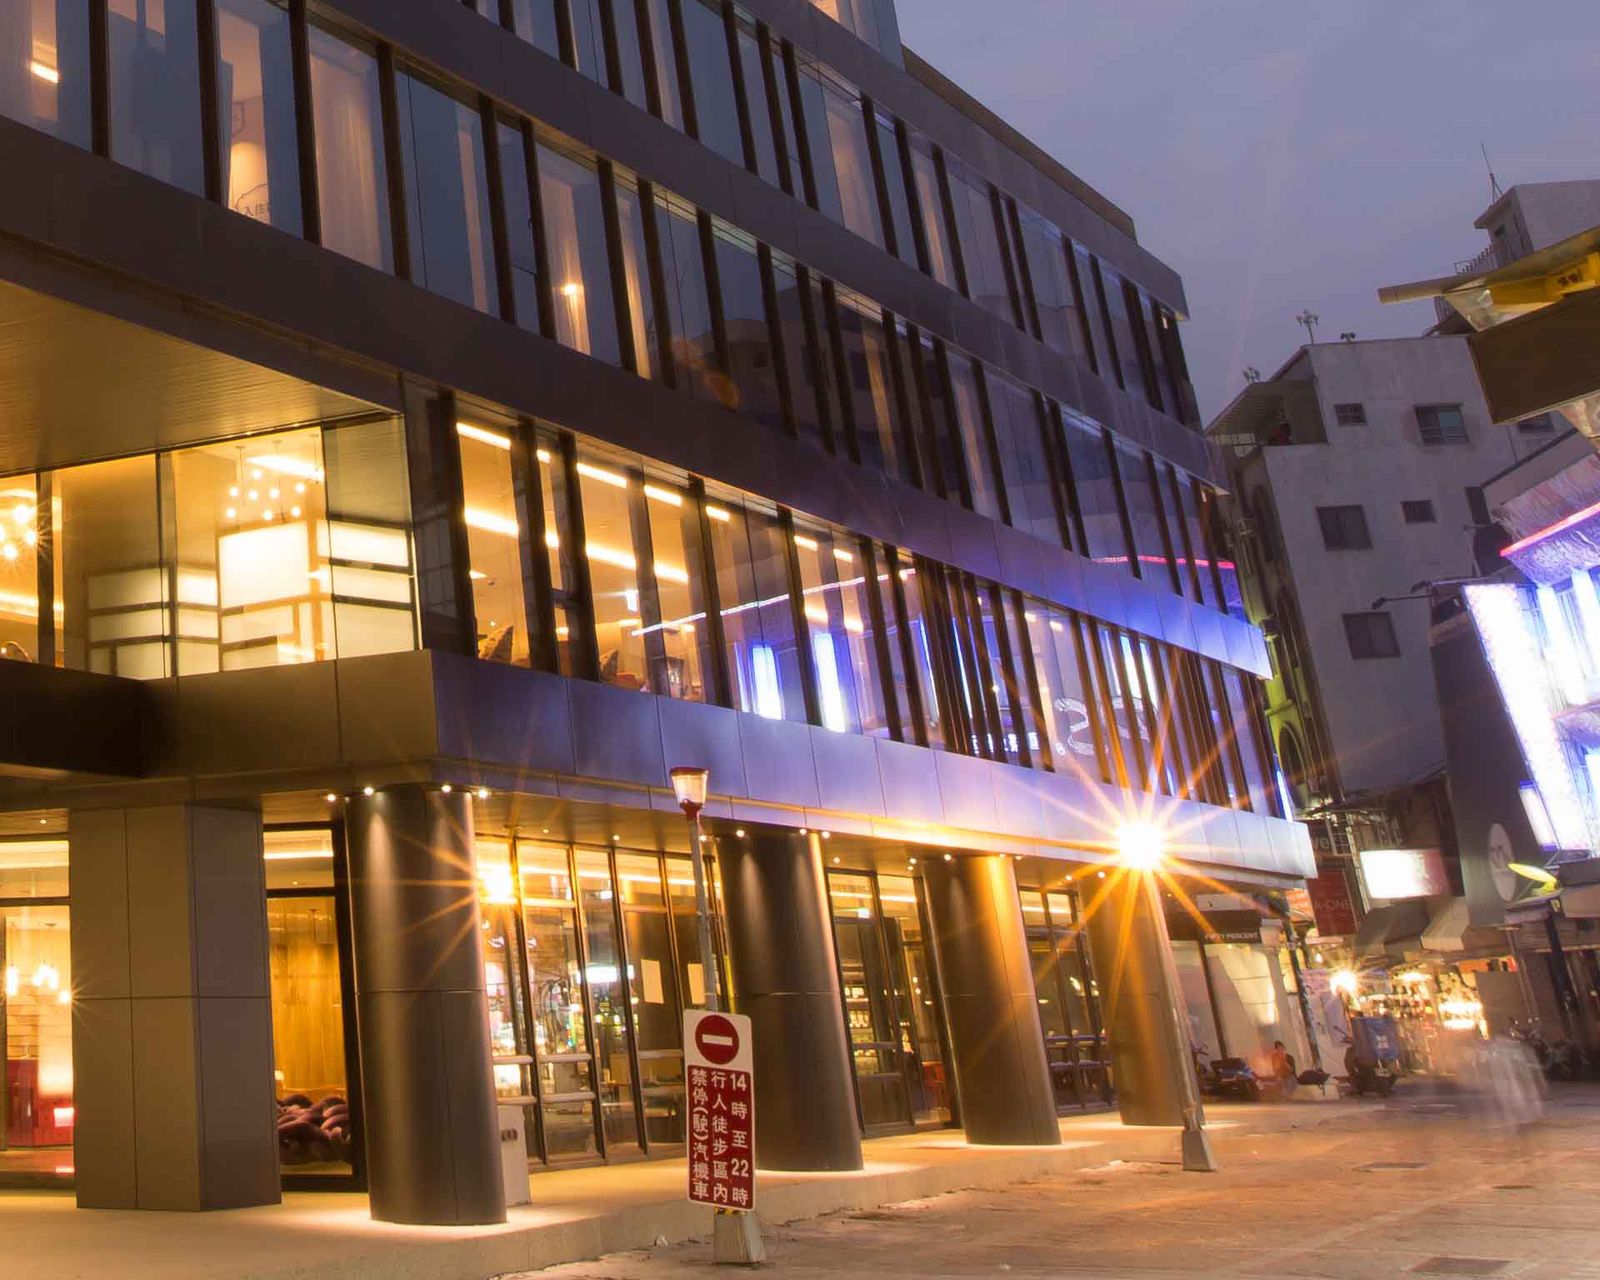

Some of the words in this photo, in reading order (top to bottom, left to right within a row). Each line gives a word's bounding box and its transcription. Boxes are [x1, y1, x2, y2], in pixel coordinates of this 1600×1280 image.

[1226, 932, 1258, 940] PERCENT
[711, 1071, 729, 1203] 行人徒步區內
[730, 1074, 749, 1206] 14時至22時
